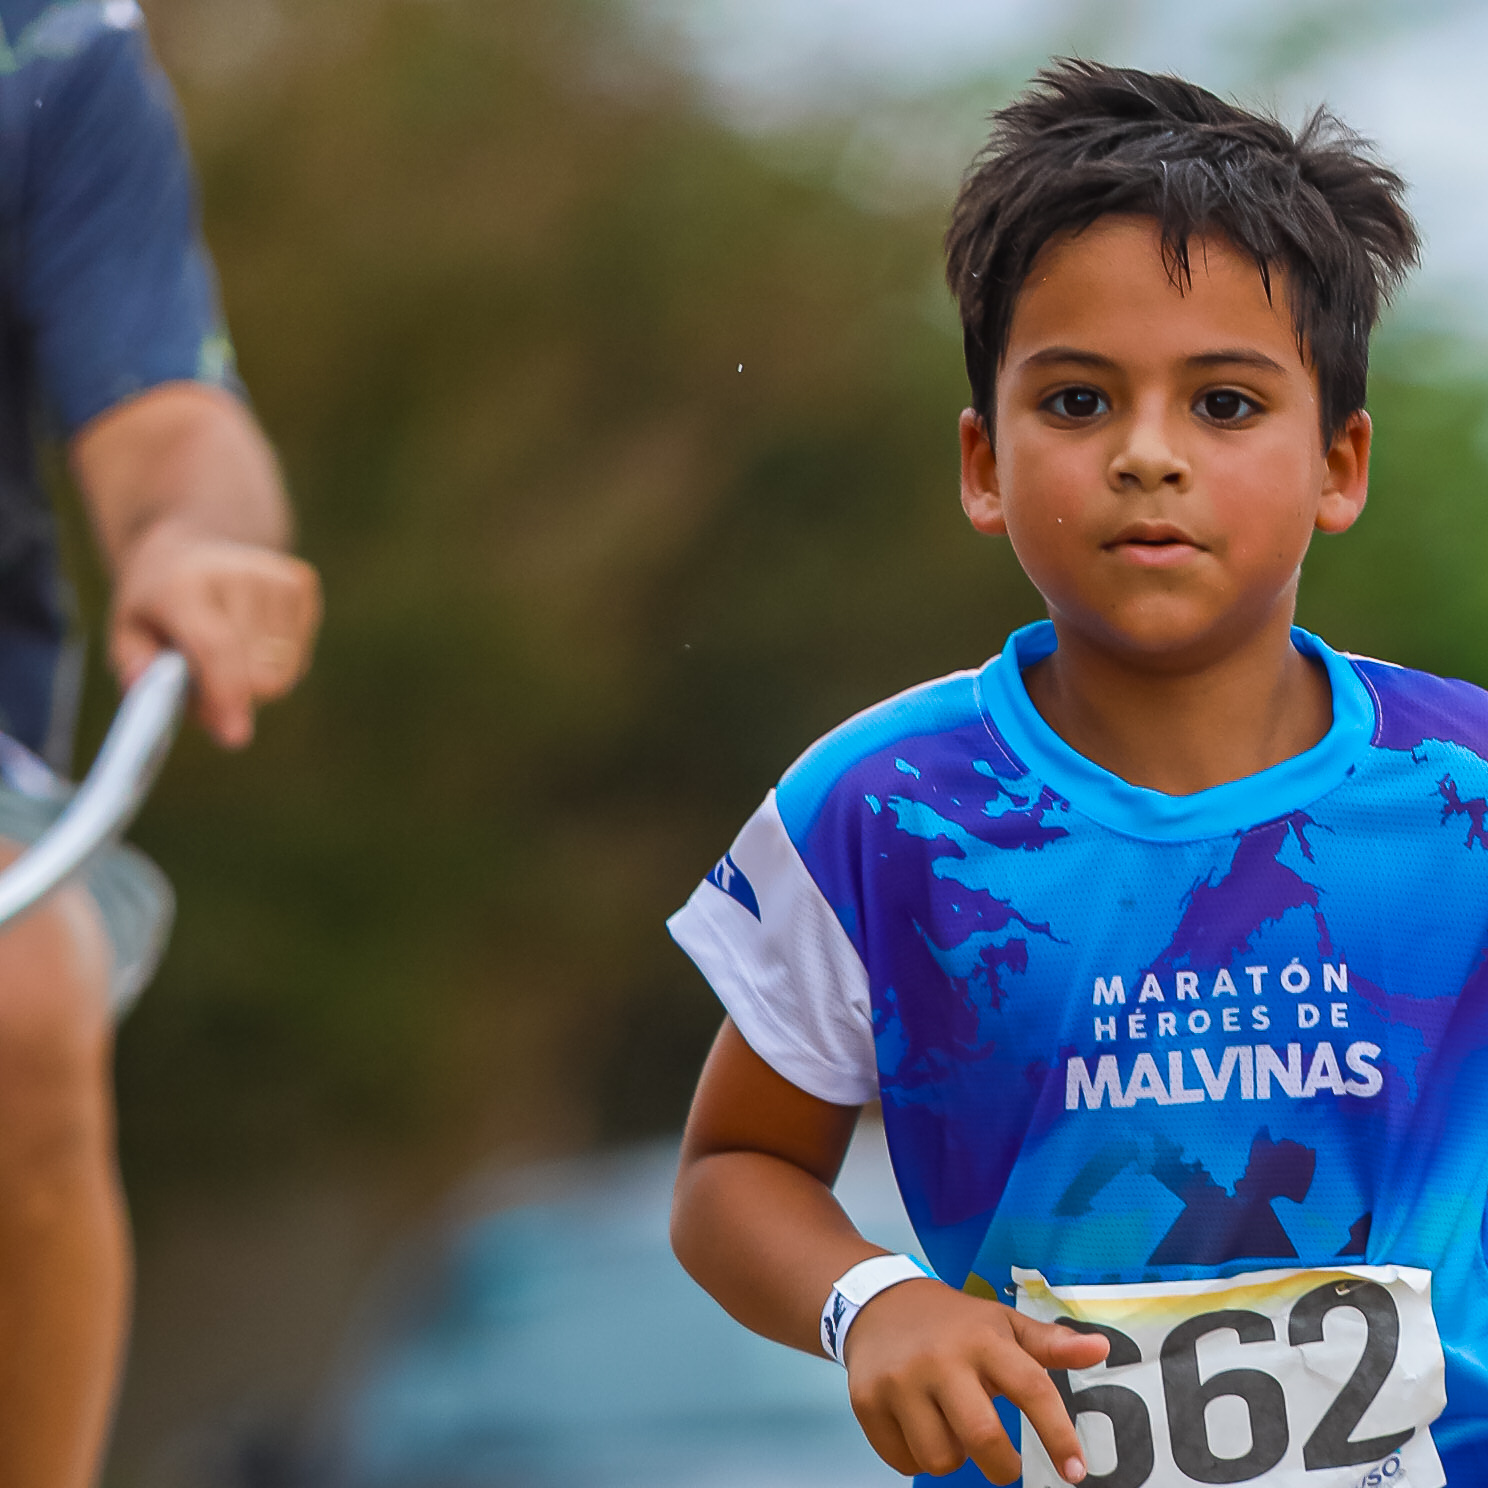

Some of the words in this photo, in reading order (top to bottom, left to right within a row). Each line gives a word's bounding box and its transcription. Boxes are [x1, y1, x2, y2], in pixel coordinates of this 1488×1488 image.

[1092, 957, 1349, 1006] MARATÓN
[1093, 1004, 1271, 1041] HÉROES
[1297, 1002, 1349, 1029] DE
[1065, 1041, 1384, 1111] MALVINAS
